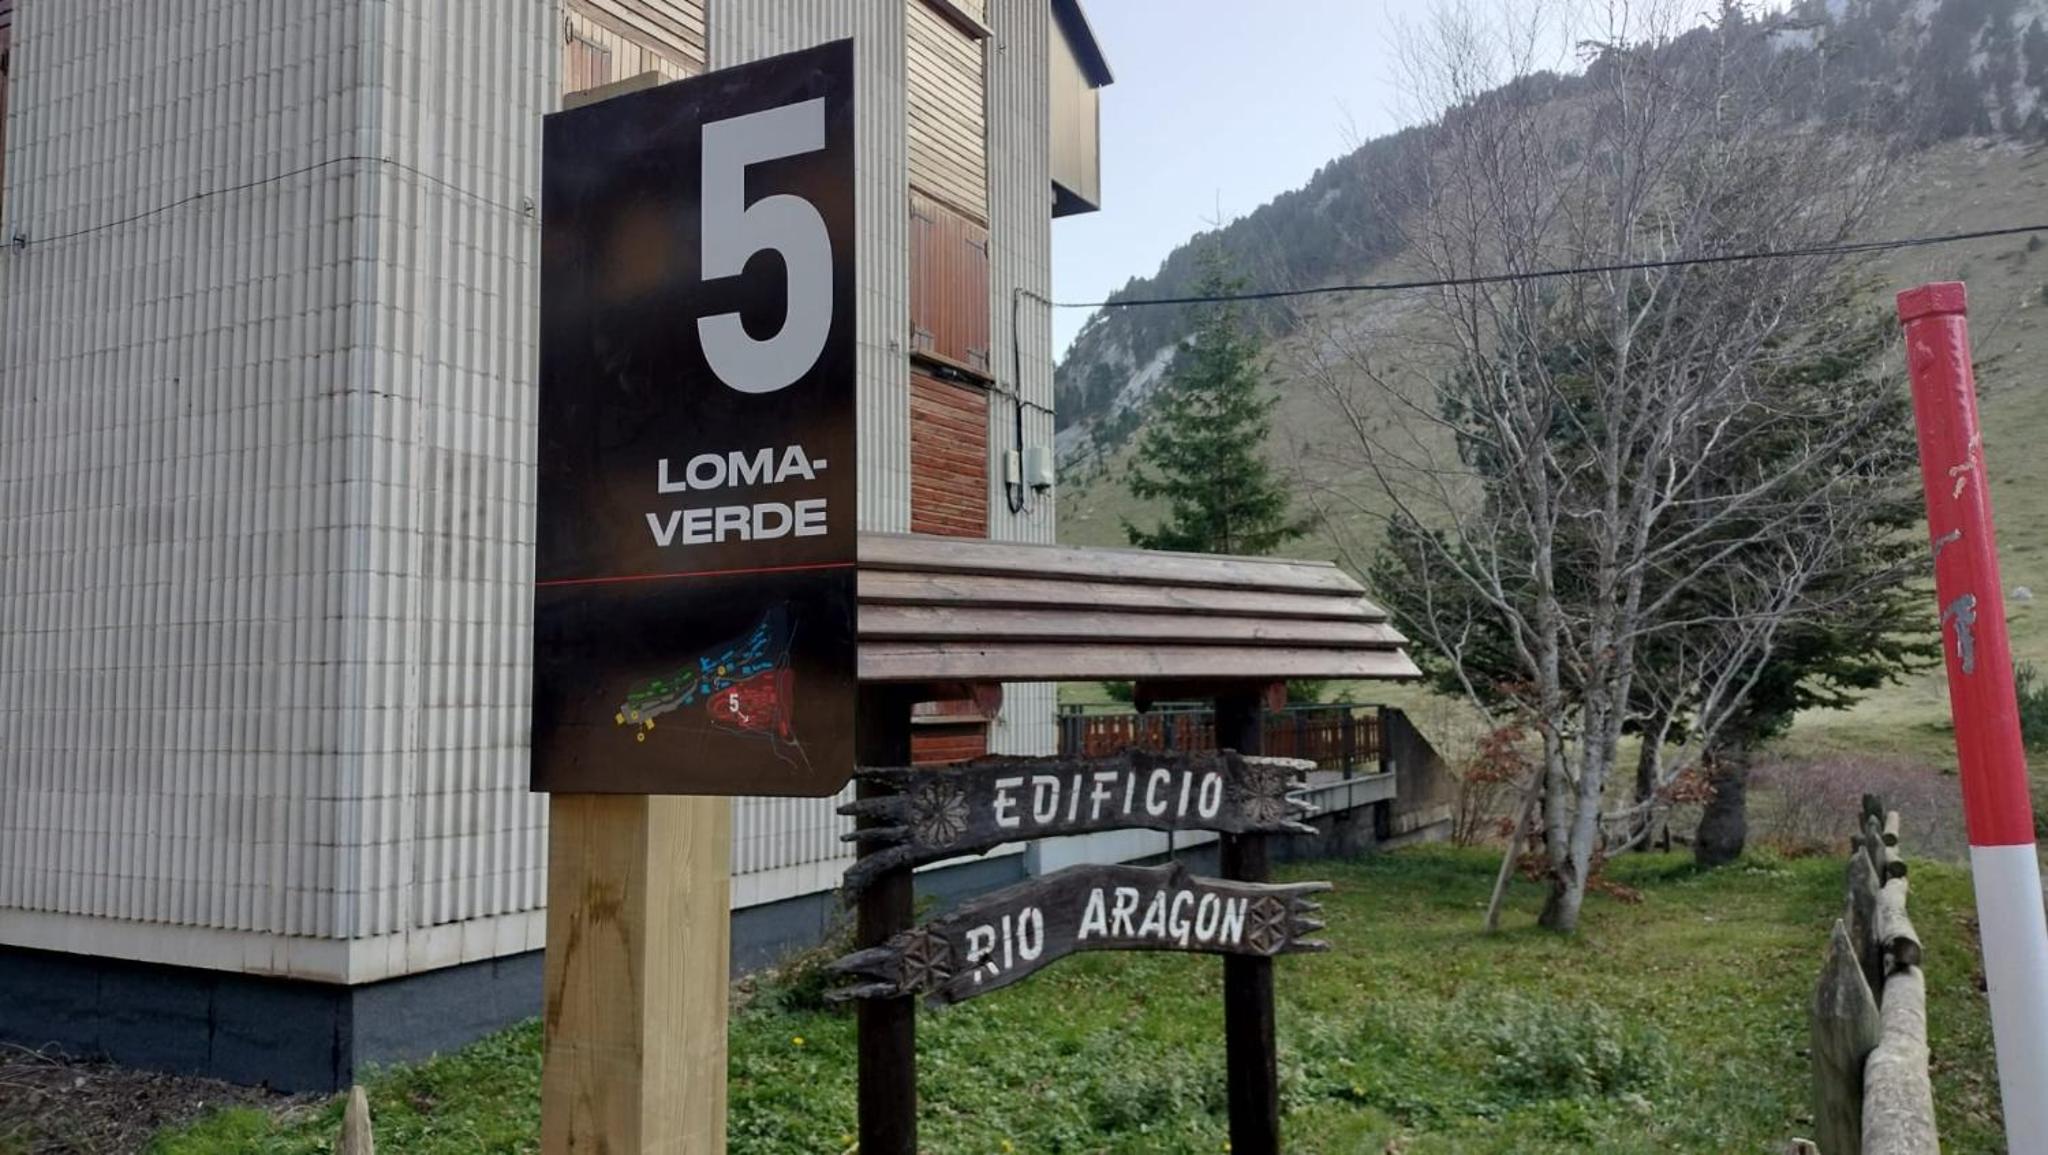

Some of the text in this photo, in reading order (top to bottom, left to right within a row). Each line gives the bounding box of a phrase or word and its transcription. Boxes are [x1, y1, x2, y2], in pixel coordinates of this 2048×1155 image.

[697, 96, 833, 393] 5
[657, 445, 828, 494] LOMA-
[646, 498, 828, 547] VERDE
[728, 693, 739, 713] 5
[993, 768, 1222, 828] EDIFICIO
[966, 887, 1248, 982] RIO ARAGON
